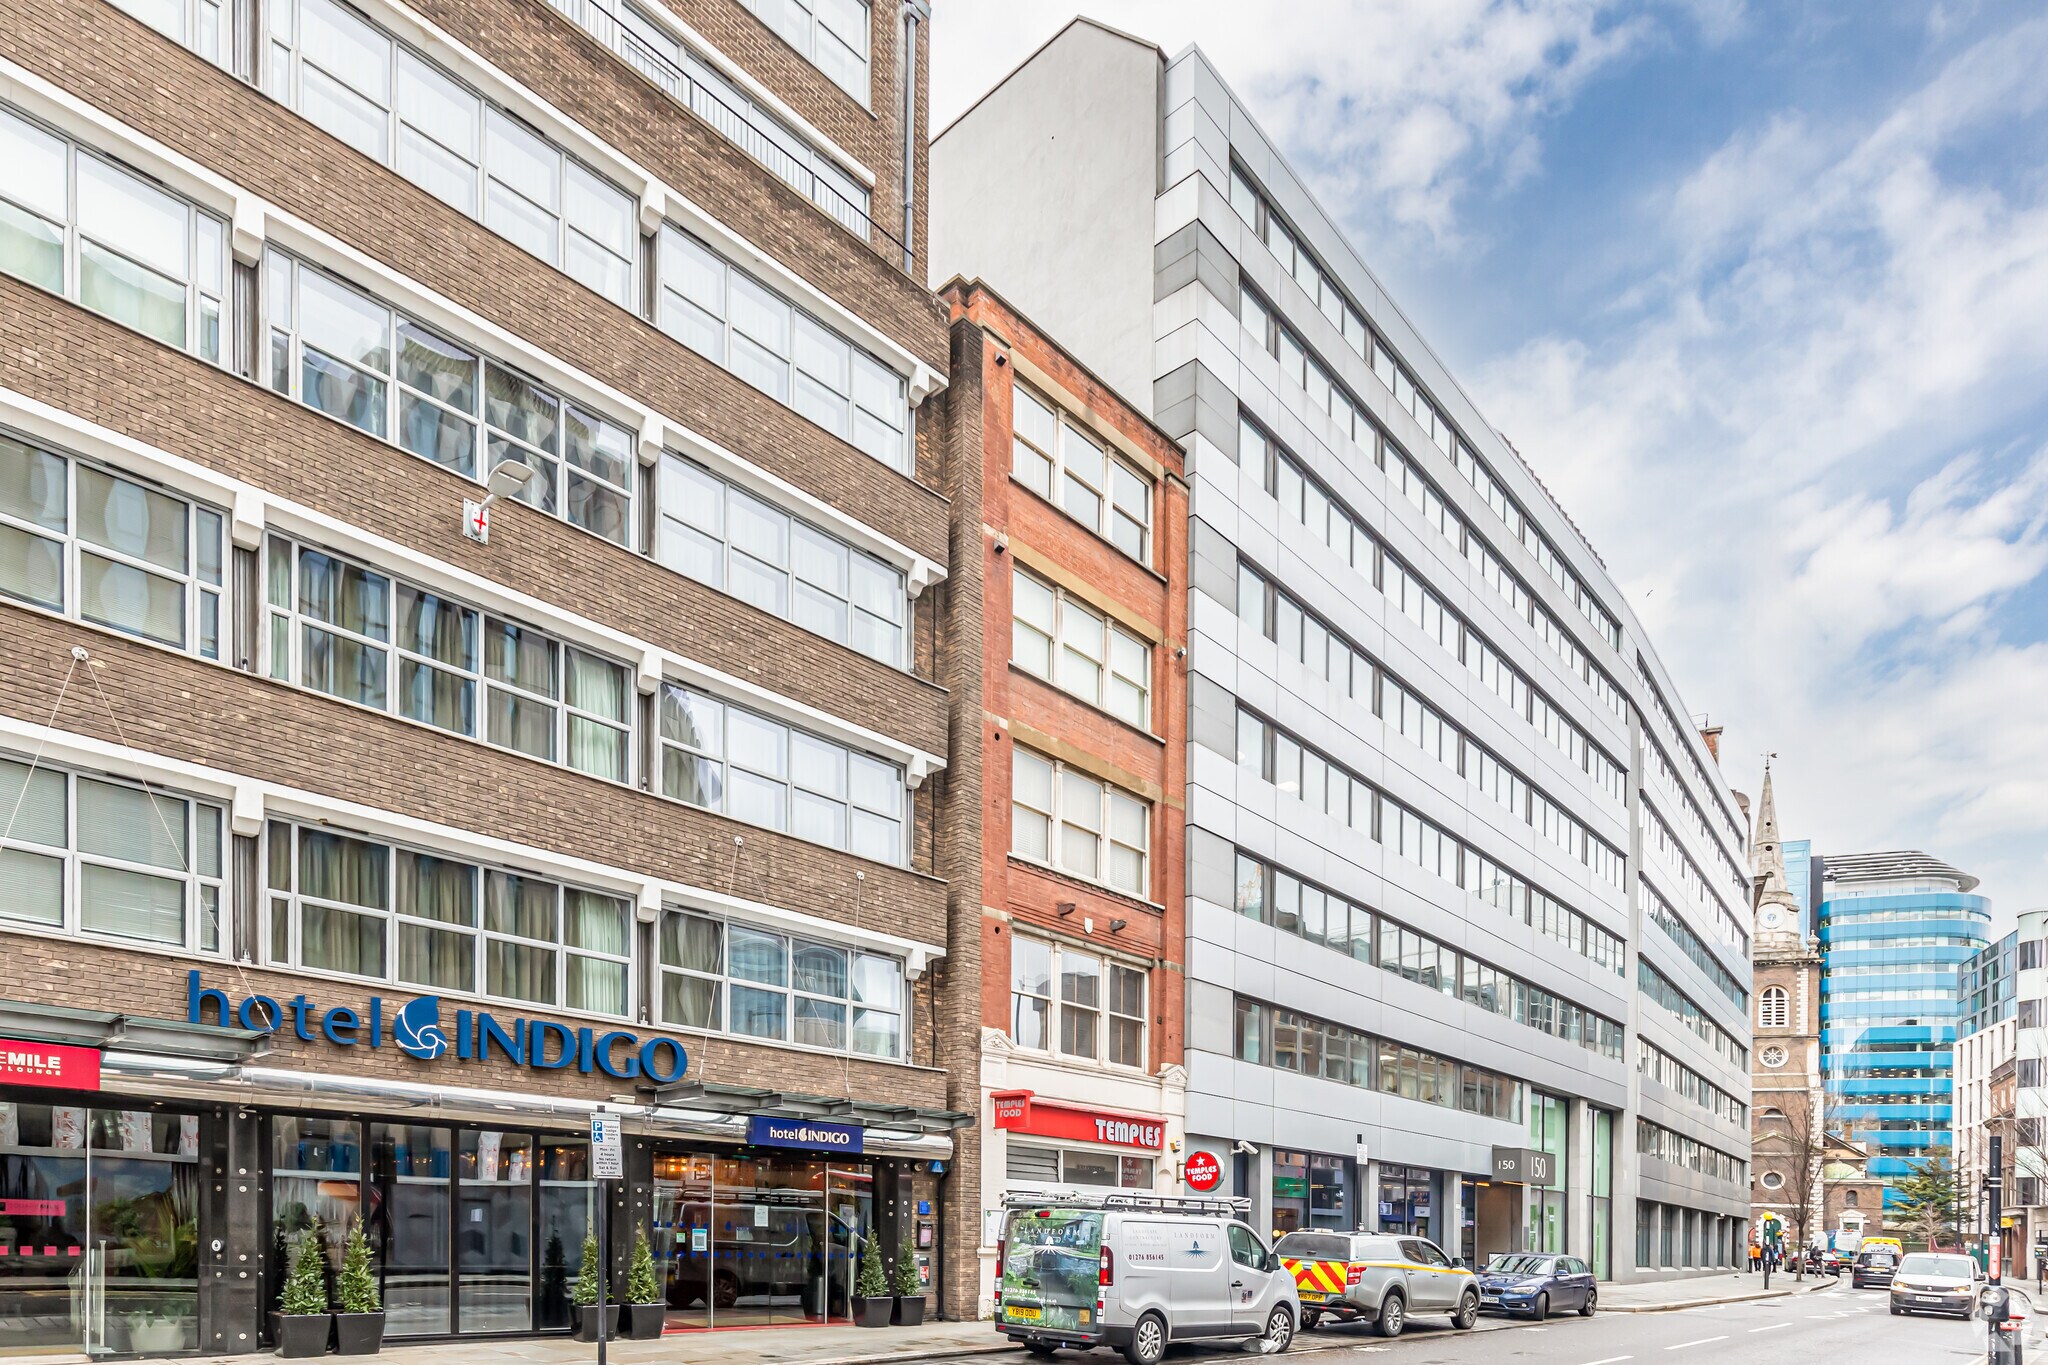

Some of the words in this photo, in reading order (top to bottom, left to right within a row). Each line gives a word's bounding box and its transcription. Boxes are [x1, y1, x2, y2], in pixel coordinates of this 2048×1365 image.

[188, 970, 381, 1048] hotel
[457, 1009, 689, 1084] INDIGO
[7, 1065, 61, 1076] LOUNGE
[996, 1099, 1025, 1110] TEMPLES
[1000, 1109, 1022, 1118] FOOD
[769, 1126, 798, 1140] hotel
[807, 1129, 850, 1145] INDIGO
[1095, 1118, 1161, 1148] TEMPLES
[1186, 1165, 1217, 1176] TEMPLES
[1498, 1160, 1515, 1170] 150
[1531, 1156, 1546, 1179] 150
[1191, 1173, 1213, 1182] FOOD
[1023, 1227, 1081, 1236] LANDFORM
[1011, 1307, 1024, 1316] YB19
